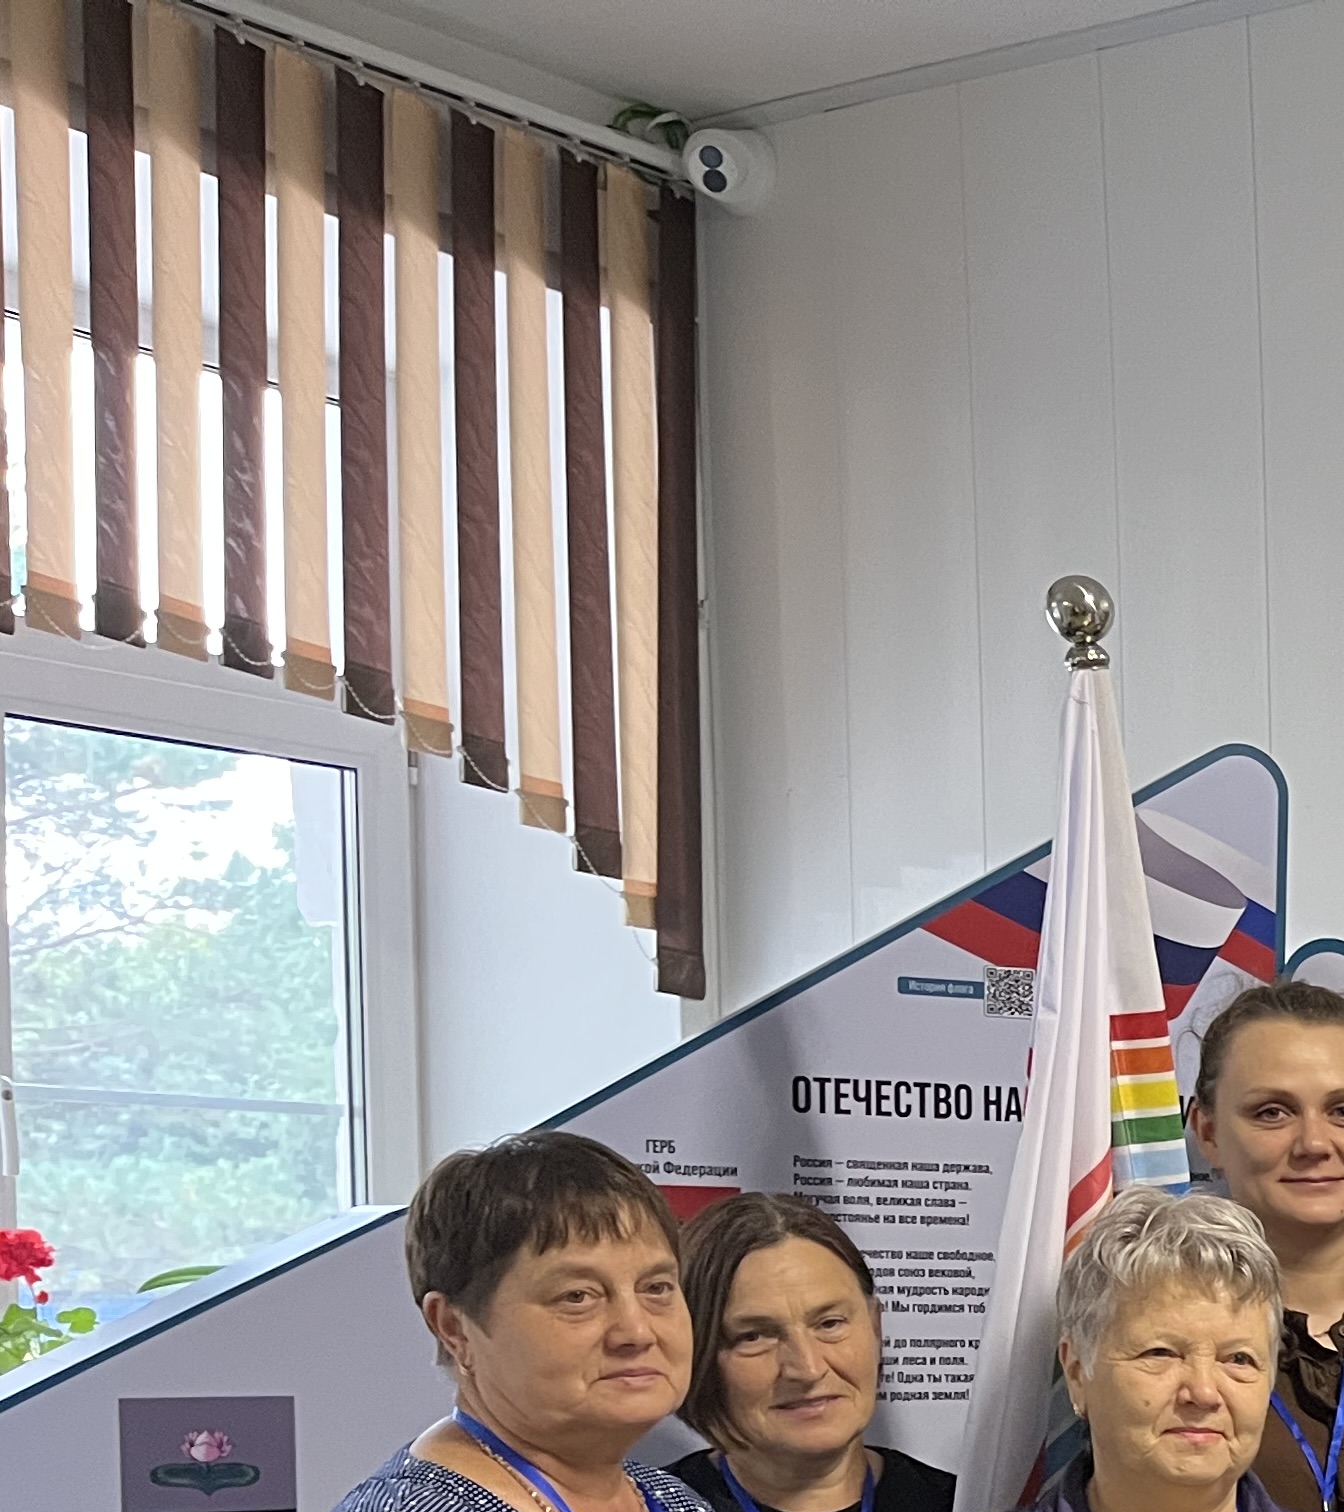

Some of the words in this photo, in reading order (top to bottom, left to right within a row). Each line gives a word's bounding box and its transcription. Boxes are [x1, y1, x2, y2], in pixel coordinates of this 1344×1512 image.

[791, 1075, 973, 1121] ОТЕЧЕСТВО
[983, 1085, 1022, 1123] НА
[645, 1139, 676, 1154] ГЕРБ
[663, 1161, 738, 1178] Федерации
[793, 1155, 832, 1169] Россия
[846, 1159, 908, 1172] священная
[911, 1161, 940, 1173] наша
[942, 1163, 993, 1175] держава,
[793, 1173, 833, 1186] Россия
[846, 1176, 898, 1188] любимая
[901, 1179, 930, 1190] наша
[843, 1196, 873, 1207] воля,
[876, 1196, 922, 1207] великая
[924, 1197, 956, 1207] слава
[899, 1215, 917, 1224] все
[920, 1213, 970, 1227] времена!
[906, 1251, 934, 1260] наше
[898, 1268, 926, 1277] союз
[928, 1267, 976, 1279] вековой,
[897, 1286, 949, 1297] мудрость
[891, 1301, 910, 1312] Мы
[912, 1303, 965, 1315] гордимся
[909, 1339, 966, 1350] полярного
[902, 1356, 927, 1366] леса
[897, 1371, 924, 1384] Одна
[889, 1391, 930, 1402] родная
[932, 1388, 969, 1401] земля!
